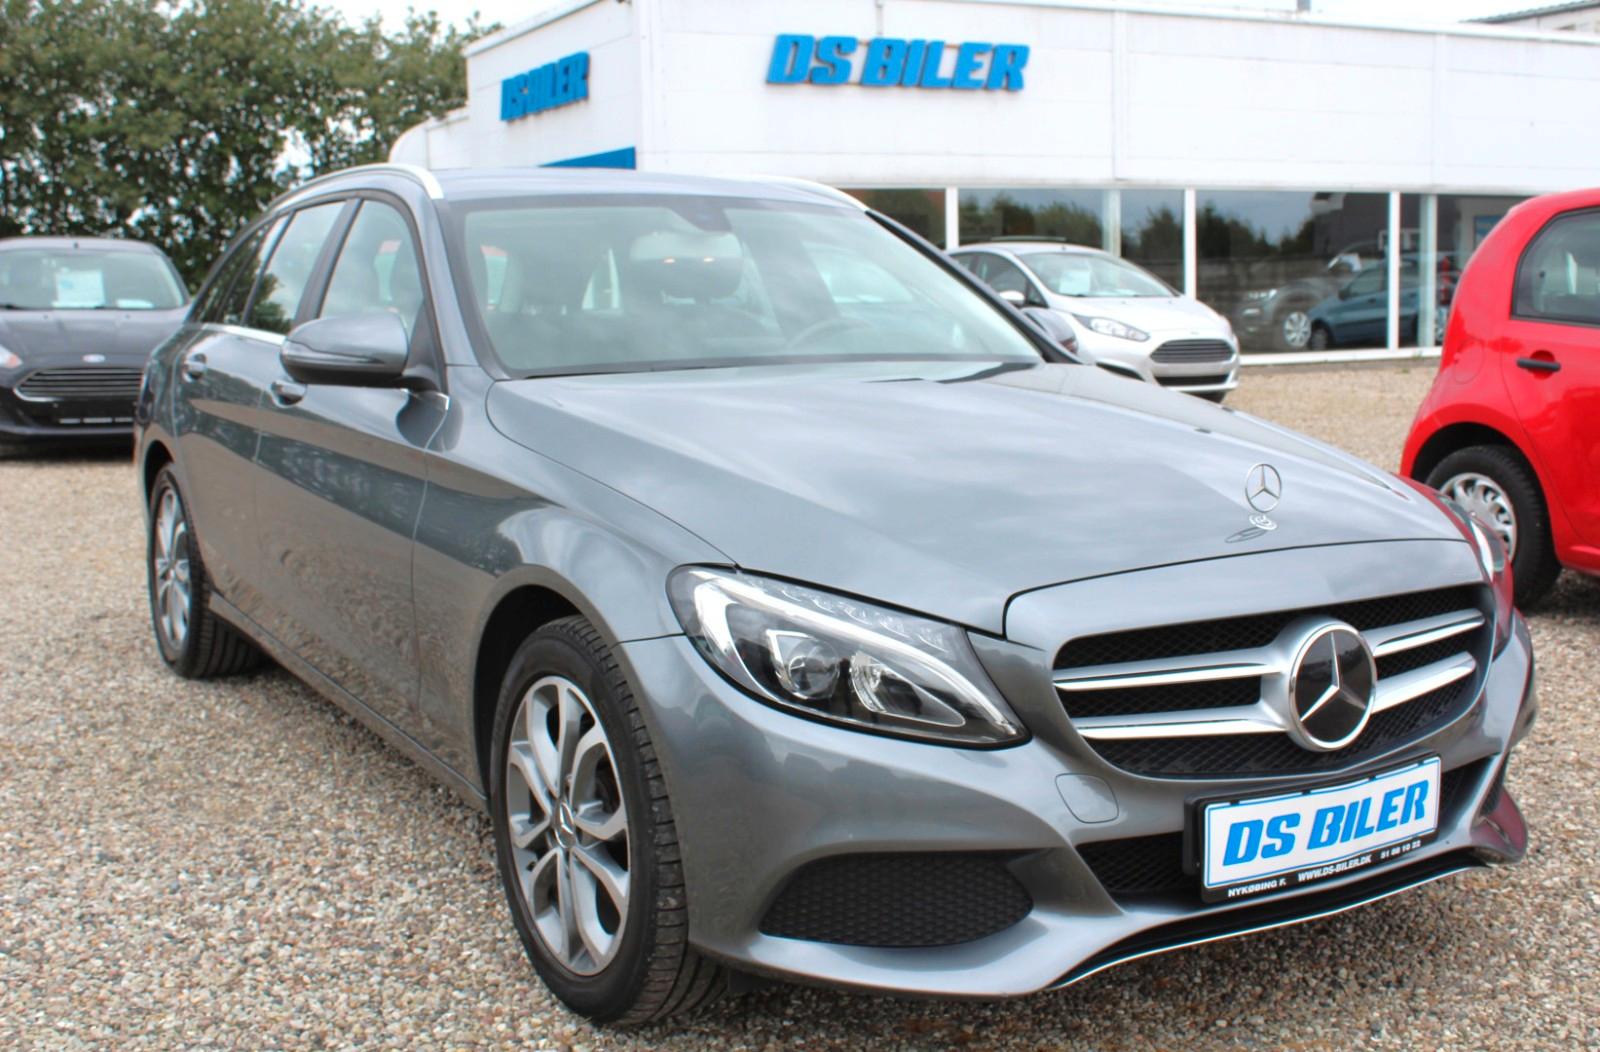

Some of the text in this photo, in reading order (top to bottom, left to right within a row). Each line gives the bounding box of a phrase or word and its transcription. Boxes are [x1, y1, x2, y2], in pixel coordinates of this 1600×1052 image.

[766, 34, 1030, 91] DS BILER
[1222, 780, 1429, 867] DS BILER
